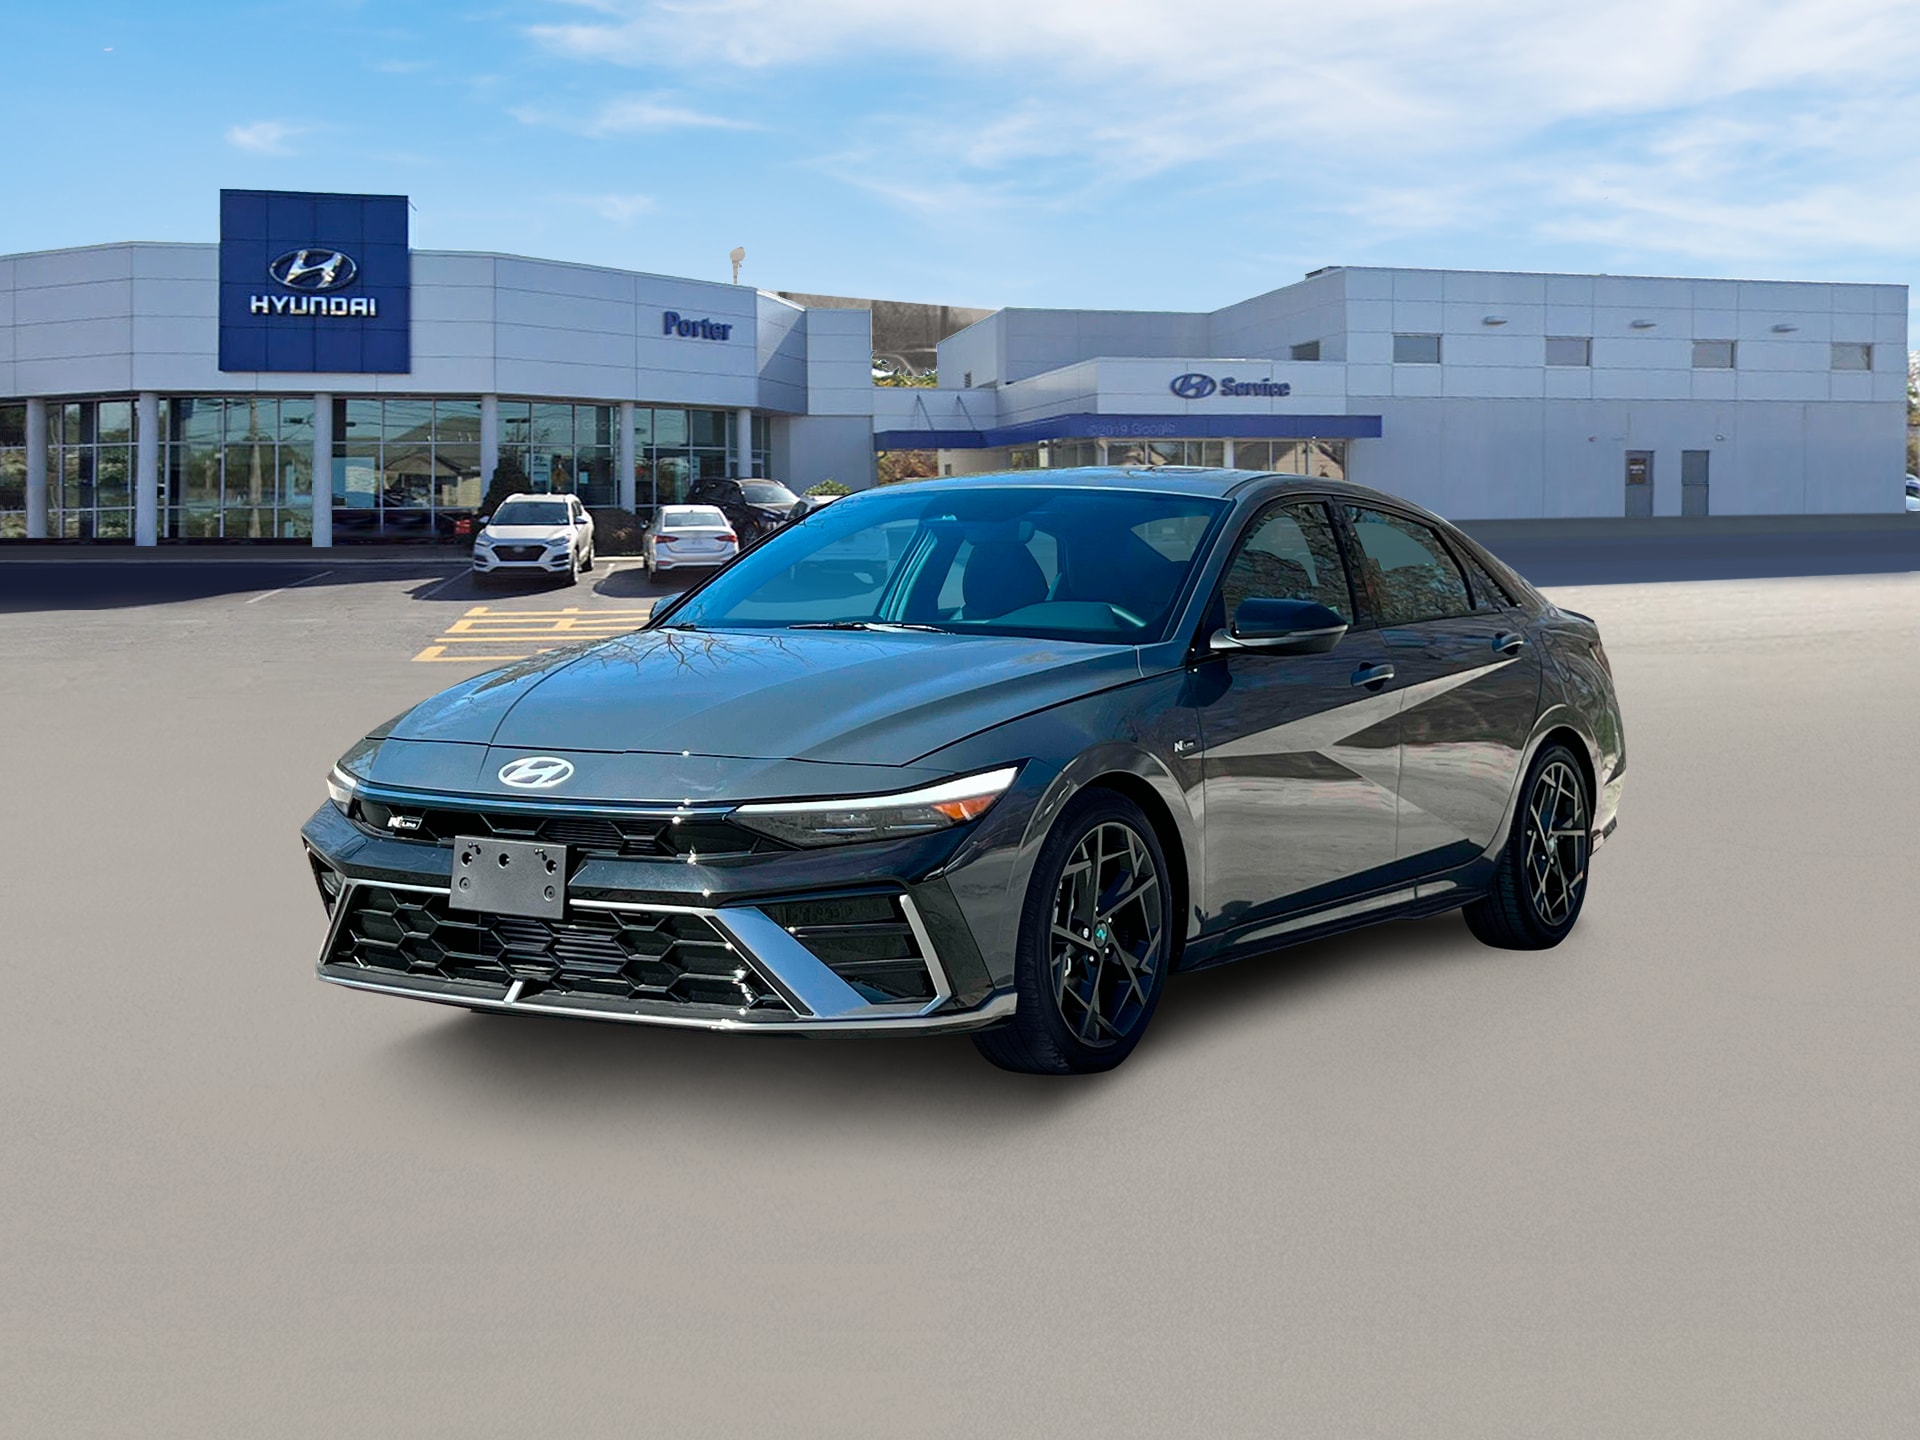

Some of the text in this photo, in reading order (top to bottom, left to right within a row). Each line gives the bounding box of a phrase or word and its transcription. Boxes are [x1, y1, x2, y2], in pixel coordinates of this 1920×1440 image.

[250, 295, 377, 316] HYUNDAI
[663, 311, 733, 340] Porter
[1220, 377, 1291, 397] Service
